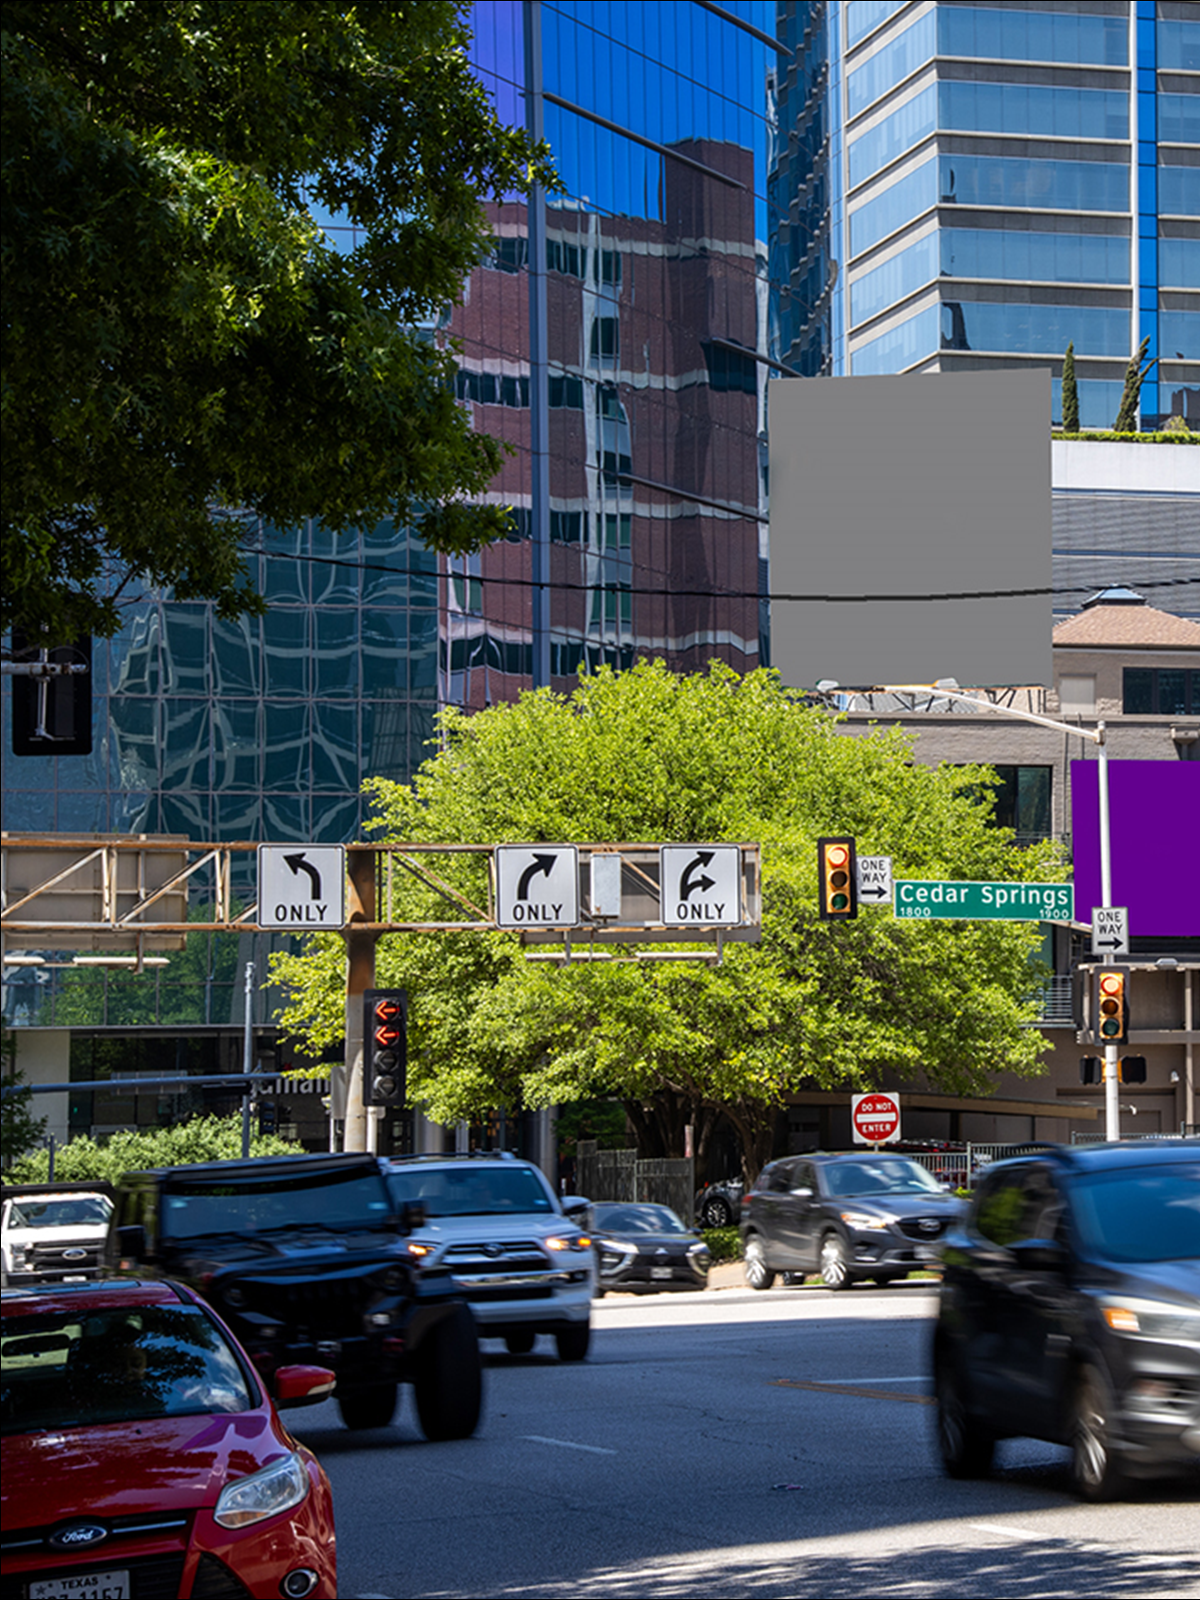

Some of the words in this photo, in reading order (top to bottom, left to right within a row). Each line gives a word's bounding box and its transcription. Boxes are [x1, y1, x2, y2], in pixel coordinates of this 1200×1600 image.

[861, 860, 886, 871] ONE
[862, 872, 887, 883] WAY
[900, 884, 969, 904] Cedar
[981, 885, 1069, 909] Springs
[274, 904, 328, 922] ONLY
[512, 904, 563, 922] ONLY
[676, 903, 725, 920] ONLY
[900, 906, 931, 917] 1800
[1039, 908, 1069, 919] 1900
[1097, 911, 1122, 923] ONE
[1098, 924, 1123, 935] WAY
[861, 1103, 873, 1112] DO
[875, 1102, 892, 1111] NOT
[862, 1123, 891, 1133] ENTER
[62, 1528, 95, 1544] Ford
[61, 1576, 99, 1590] TEXAS
